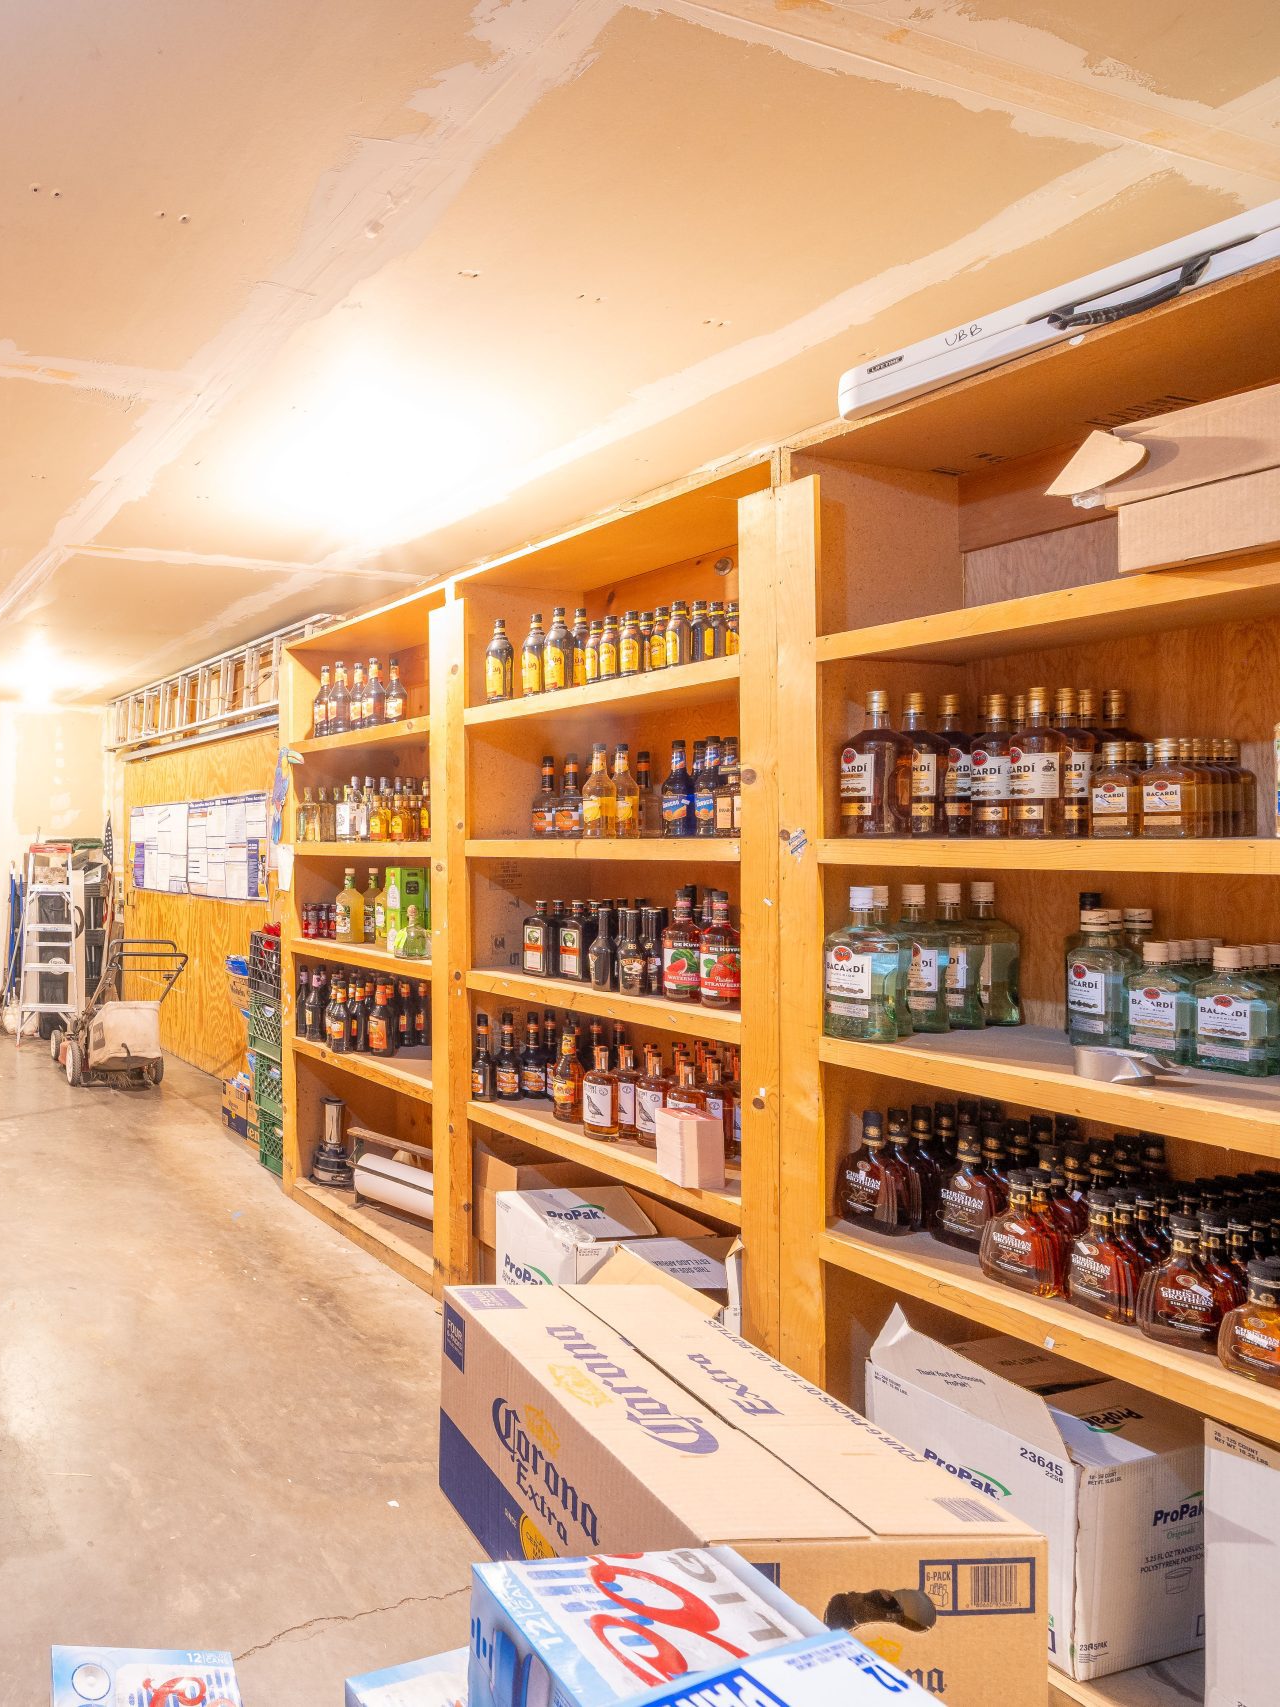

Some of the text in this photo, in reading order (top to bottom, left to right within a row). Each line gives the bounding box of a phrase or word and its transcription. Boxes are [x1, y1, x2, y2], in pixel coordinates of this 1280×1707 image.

[941, 1188, 984, 1206] CHRISTIAN
[941, 1194, 983, 1211] BROTHERS
[992, 1231, 1033, 1248] CHRISTIAN
[992, 1237, 1032, 1252] BROTHERS
[1071, 1253, 1111, 1273] CHRISTIAN
[1071, 1259, 1111, 1277] BROTHERS
[1160, 1286, 1214, 1303] CHRISTIAN
[1160, 1292, 1214, 1308] BROTHERS
[447, 1318, 463, 1342] FOUR
[703, 1319, 753, 1349] BOTTLES
[546, 1324, 720, 1455] Corona
[686, 1352, 786, 1417] Extra
[799, 1383, 822, 1396] OF
[1214, 1436, 1227, 1446] NET
[1237, 1441, 1260, 1455] COUNT
[879, 1436, 926, 1464] FOUR
[1020, 1447, 1064, 1477] 23645
[491, 1397, 600, 1547] Corona
[1045, 1470, 1064, 1484] 2250
[516, 1458, 569, 1546] Extra
[1164, 1550, 1174, 1559] OZ
[1140, 1557, 1181, 1575] POLYSTYRENE
[925, 1570, 952, 1583] 6-PACK
[186, 1652, 203, 1664] 12
